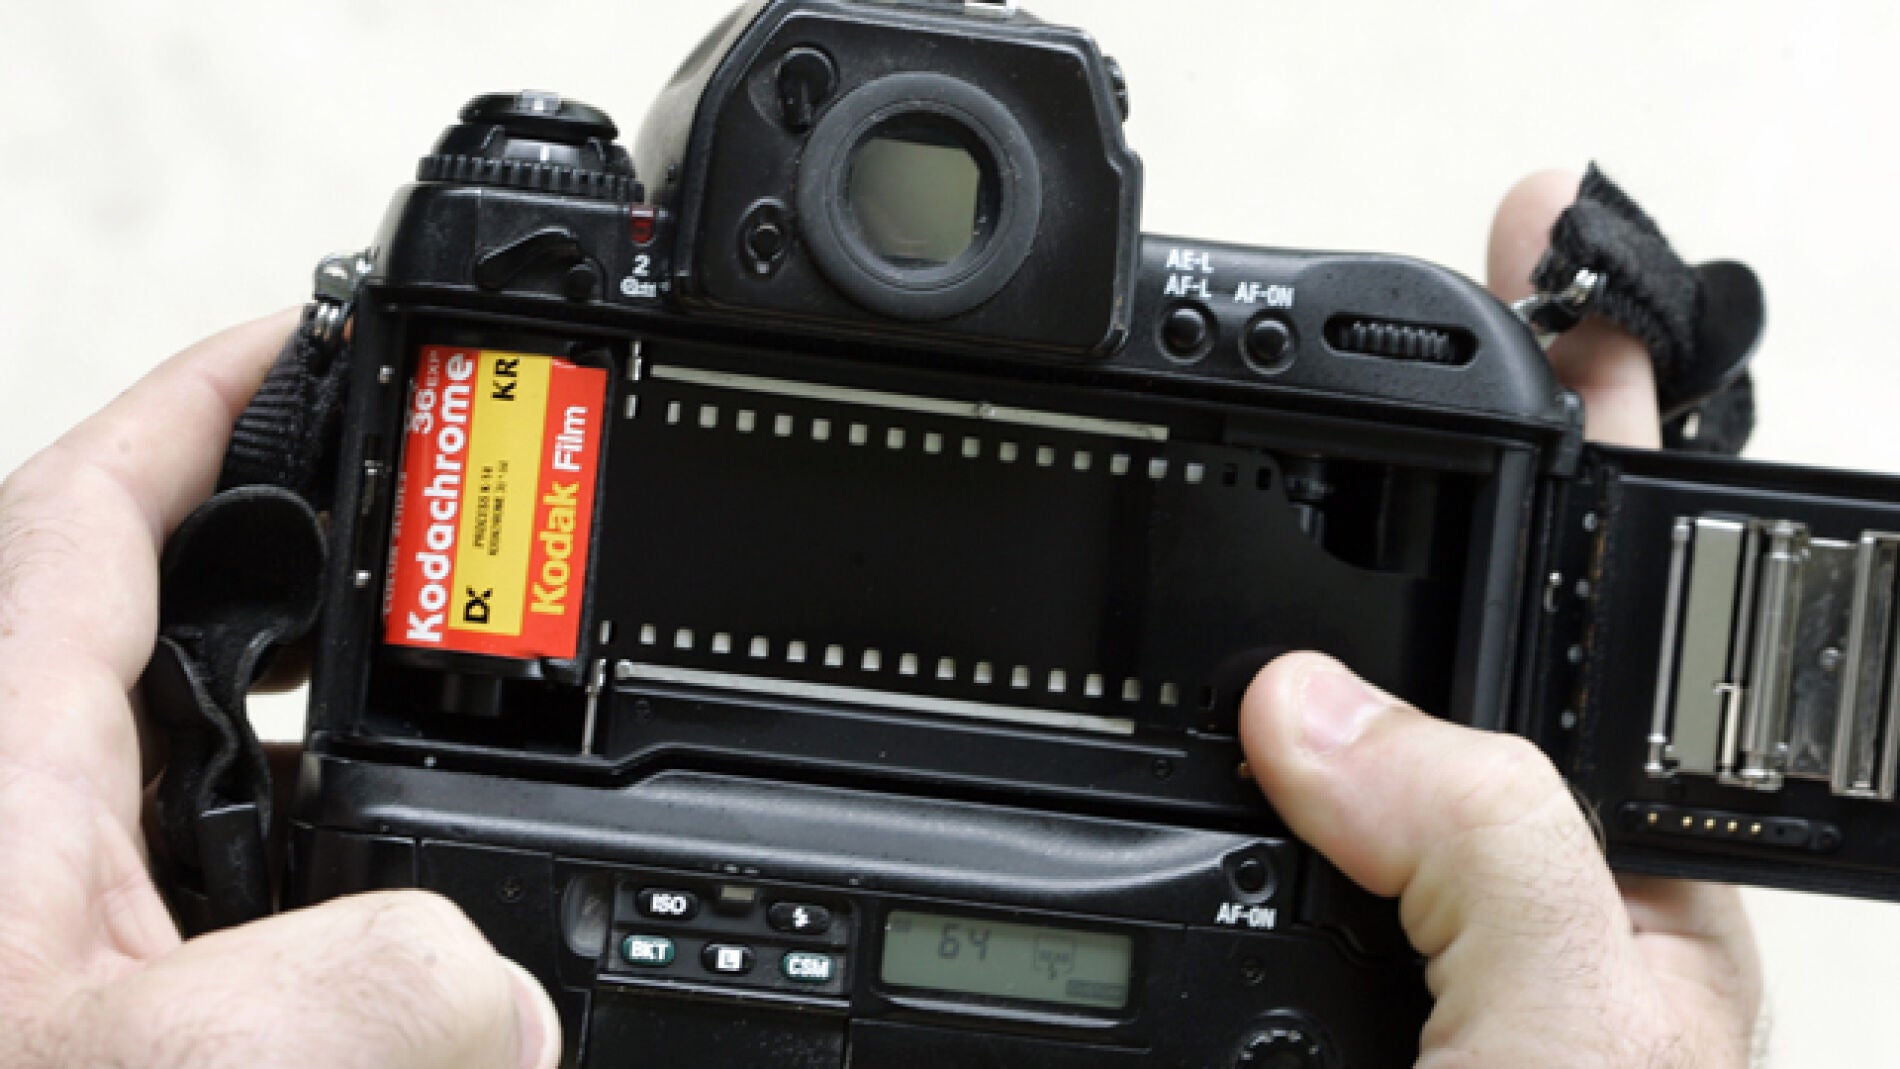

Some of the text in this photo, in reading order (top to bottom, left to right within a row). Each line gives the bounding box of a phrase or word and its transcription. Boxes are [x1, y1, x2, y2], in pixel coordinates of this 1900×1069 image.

[633, 254, 650, 276] 2
[1166, 249, 1214, 273] AE-L
[1164, 273, 1212, 298] AF-L
[1234, 281, 1295, 308] AF-ON
[490, 357, 520, 402] KR
[409, 387, 437, 435] 36
[406, 352, 474, 642] Kodachrome
[531, 405, 589, 616] Kodak Film
[1215, 902, 1277, 929] AF-ON
[938, 922, 993, 962] 64
